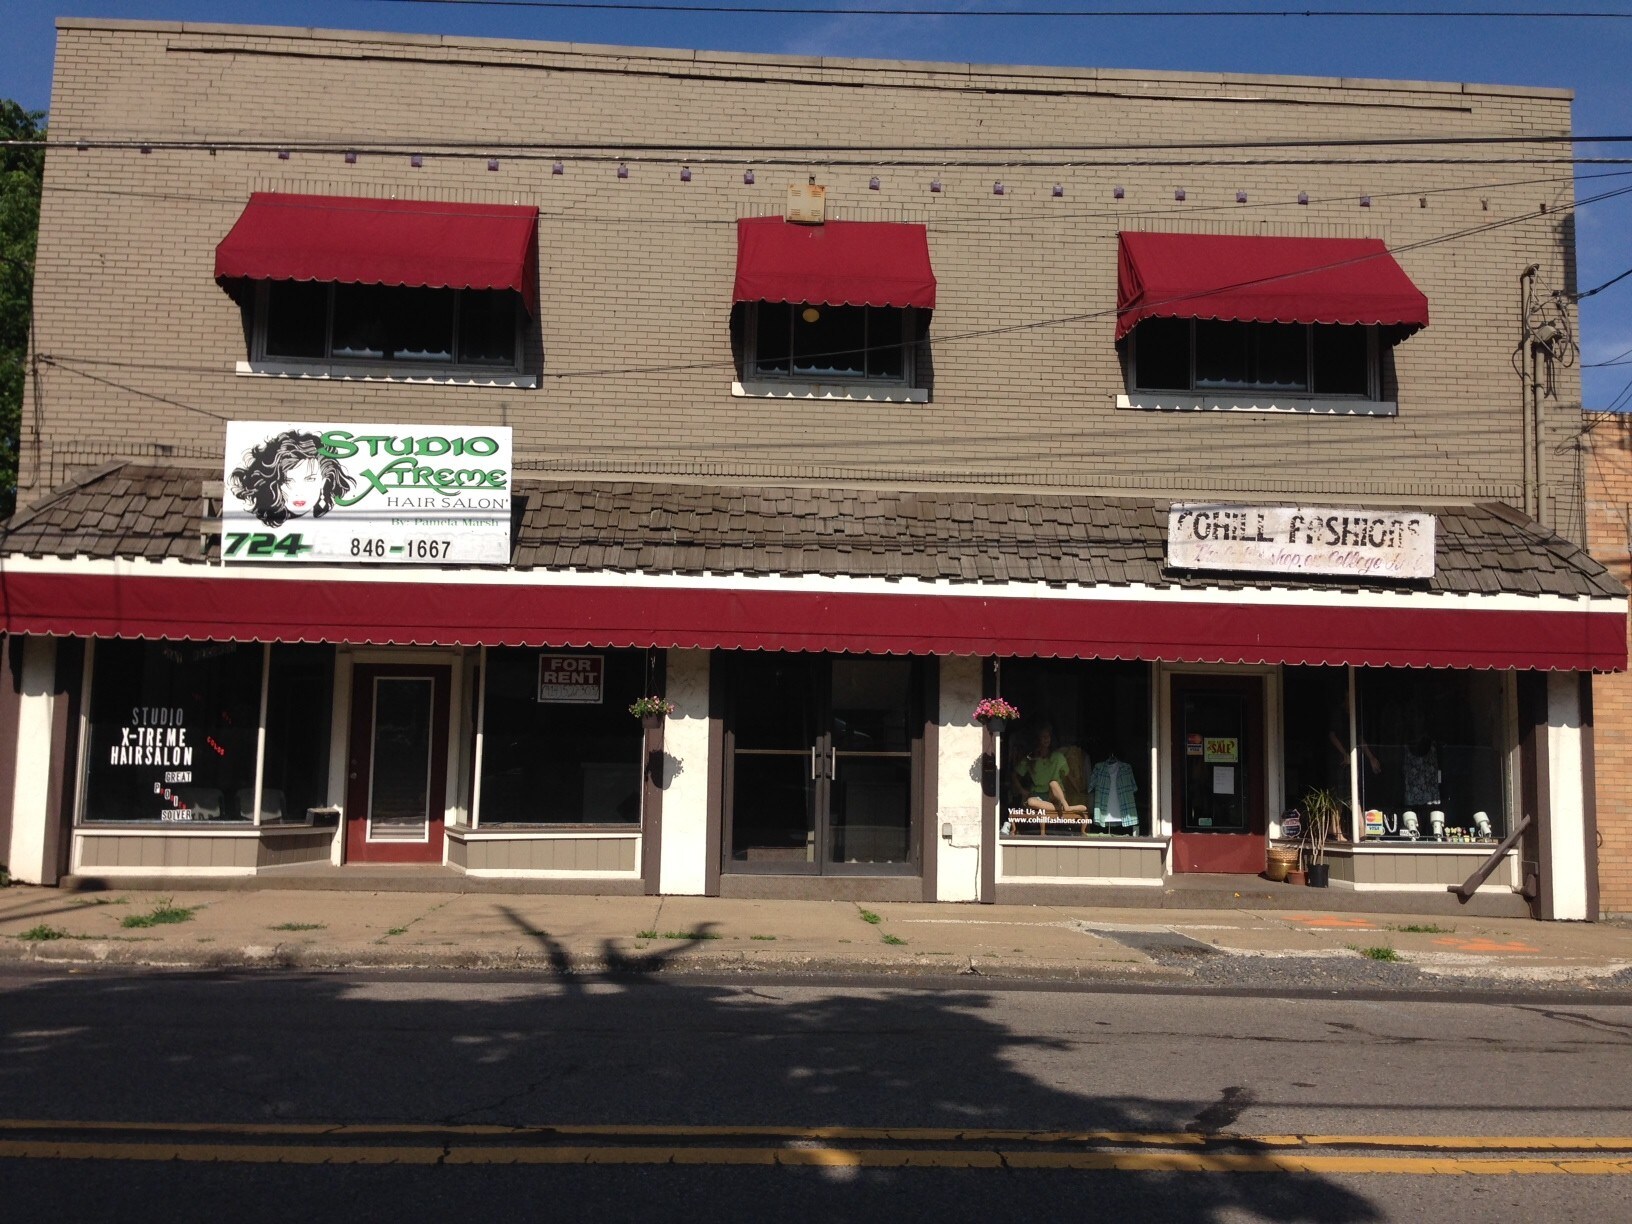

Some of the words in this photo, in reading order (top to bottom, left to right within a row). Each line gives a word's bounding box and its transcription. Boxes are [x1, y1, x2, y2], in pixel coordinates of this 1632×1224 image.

[386, 496, 437, 508] HAIR
[441, 497, 505, 509] SALON
[1328, 551, 1382, 574] College
[551, 658, 592, 671] FOR
[543, 671, 598, 684] RENT
[132, 707, 184, 726] STUDIO
[121, 727, 187, 747] X-TREME
[1211, 743, 1232, 754] SALE
[165, 772, 192, 783] GREAT
[1008, 807, 1024, 815] Visit
[1026, 808, 1036, 816] Us
[1037, 808, 1046, 816] At
[1008, 816, 1093, 825] www.cohillfashions.com
